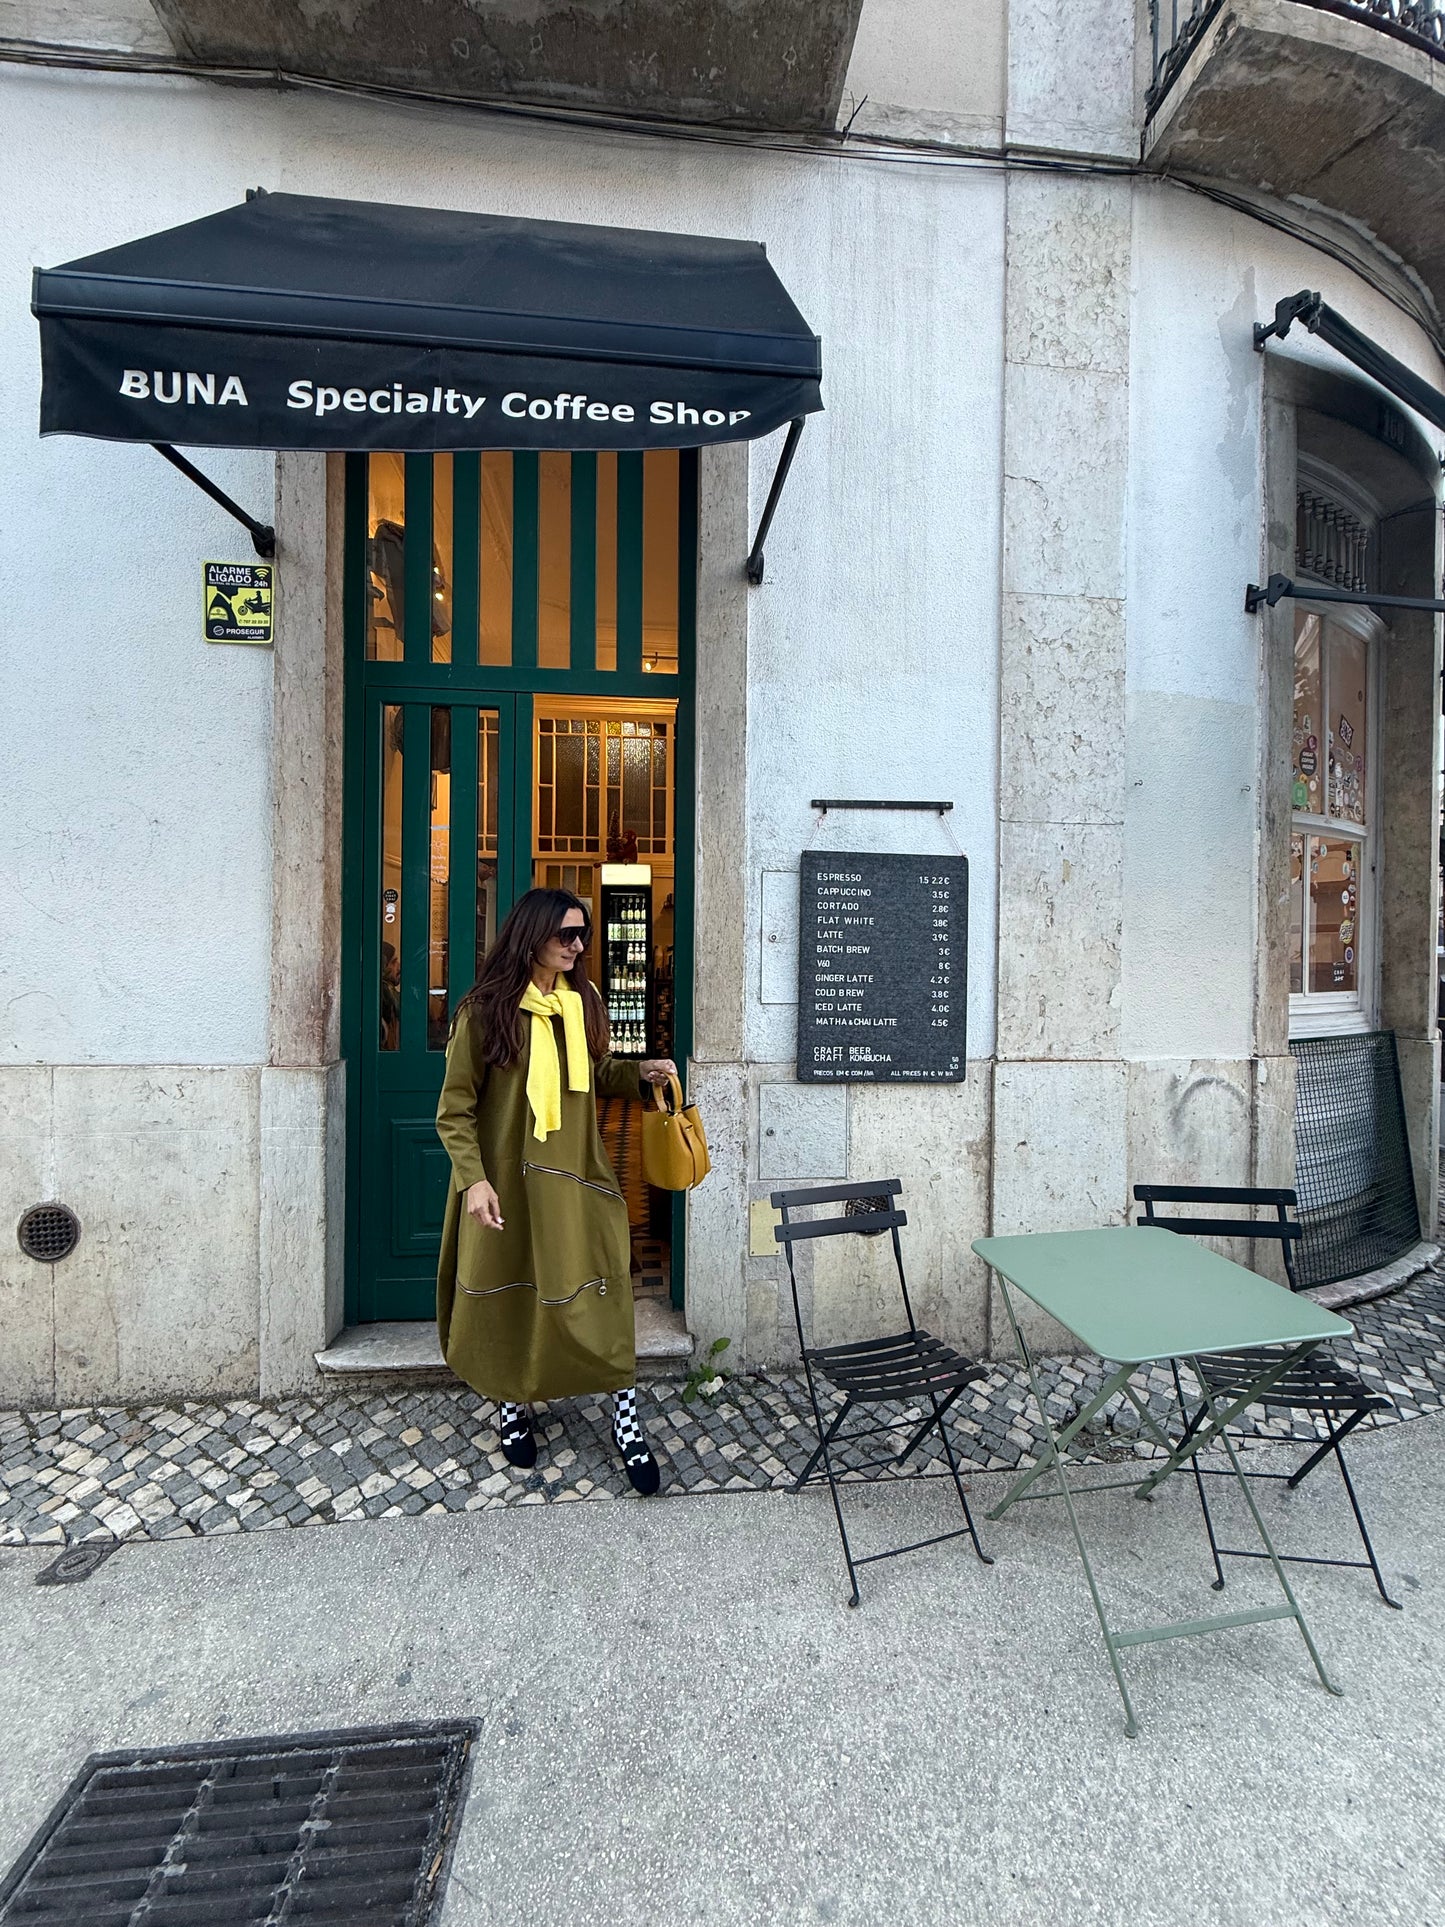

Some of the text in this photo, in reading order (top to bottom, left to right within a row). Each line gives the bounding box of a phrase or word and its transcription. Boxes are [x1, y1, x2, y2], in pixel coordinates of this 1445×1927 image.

[119, 368, 249, 407] BUNA
[286, 379, 487, 420] Specialty
[501, 392, 635, 424] Coffee
[209, 565, 251, 576] ALARME
[208, 573, 252, 583] LIGADO
[817, 873, 862, 882] ESPRESSO
[817, 888, 872, 897] CAPPUCCINO
[817, 902, 859, 911] CORTADO
[817, 916, 839, 925] FLAT
[844, 917, 875, 926] WHITE
[817, 931, 844, 939] LATTE
[816, 945, 843, 954] BATCH
[846, 946, 870, 954] BREW
[817, 960, 831, 968] V60
[815, 974, 950, 985] GINGER LATTE 4.2€
[815, 989, 836, 997] COLD
[838, 989, 865, 997] BREW
[815, 1003, 949, 1013] ICED LATTE 4.0€
[873, 1018, 898, 1027] LATTE
[813, 1046, 872, 1055] CRAFT BEER
[813, 1054, 844, 1062] CRAFT
[849, 1054, 892, 1062] KOMBUCHA
